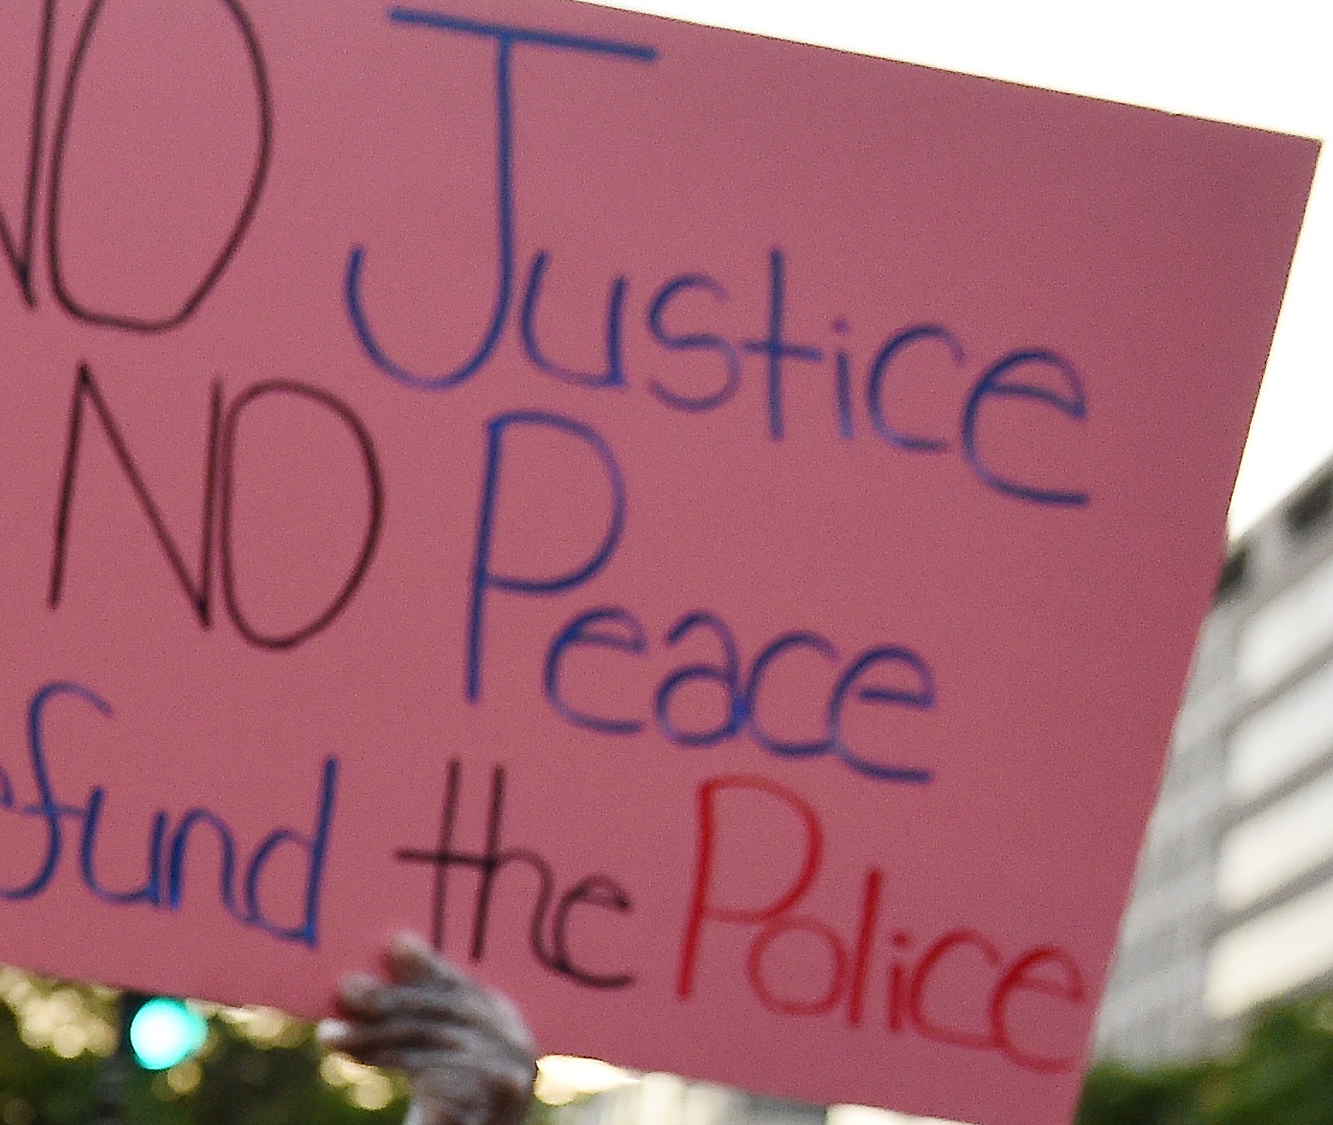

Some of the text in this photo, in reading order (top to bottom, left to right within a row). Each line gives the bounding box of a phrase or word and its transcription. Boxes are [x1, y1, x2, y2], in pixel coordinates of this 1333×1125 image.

[344, 6, 1088, 508] Justice
[47, 361, 936, 783] NO Peace
[395, 757, 635, 990] the
[677, 773, 1089, 1074] Police
